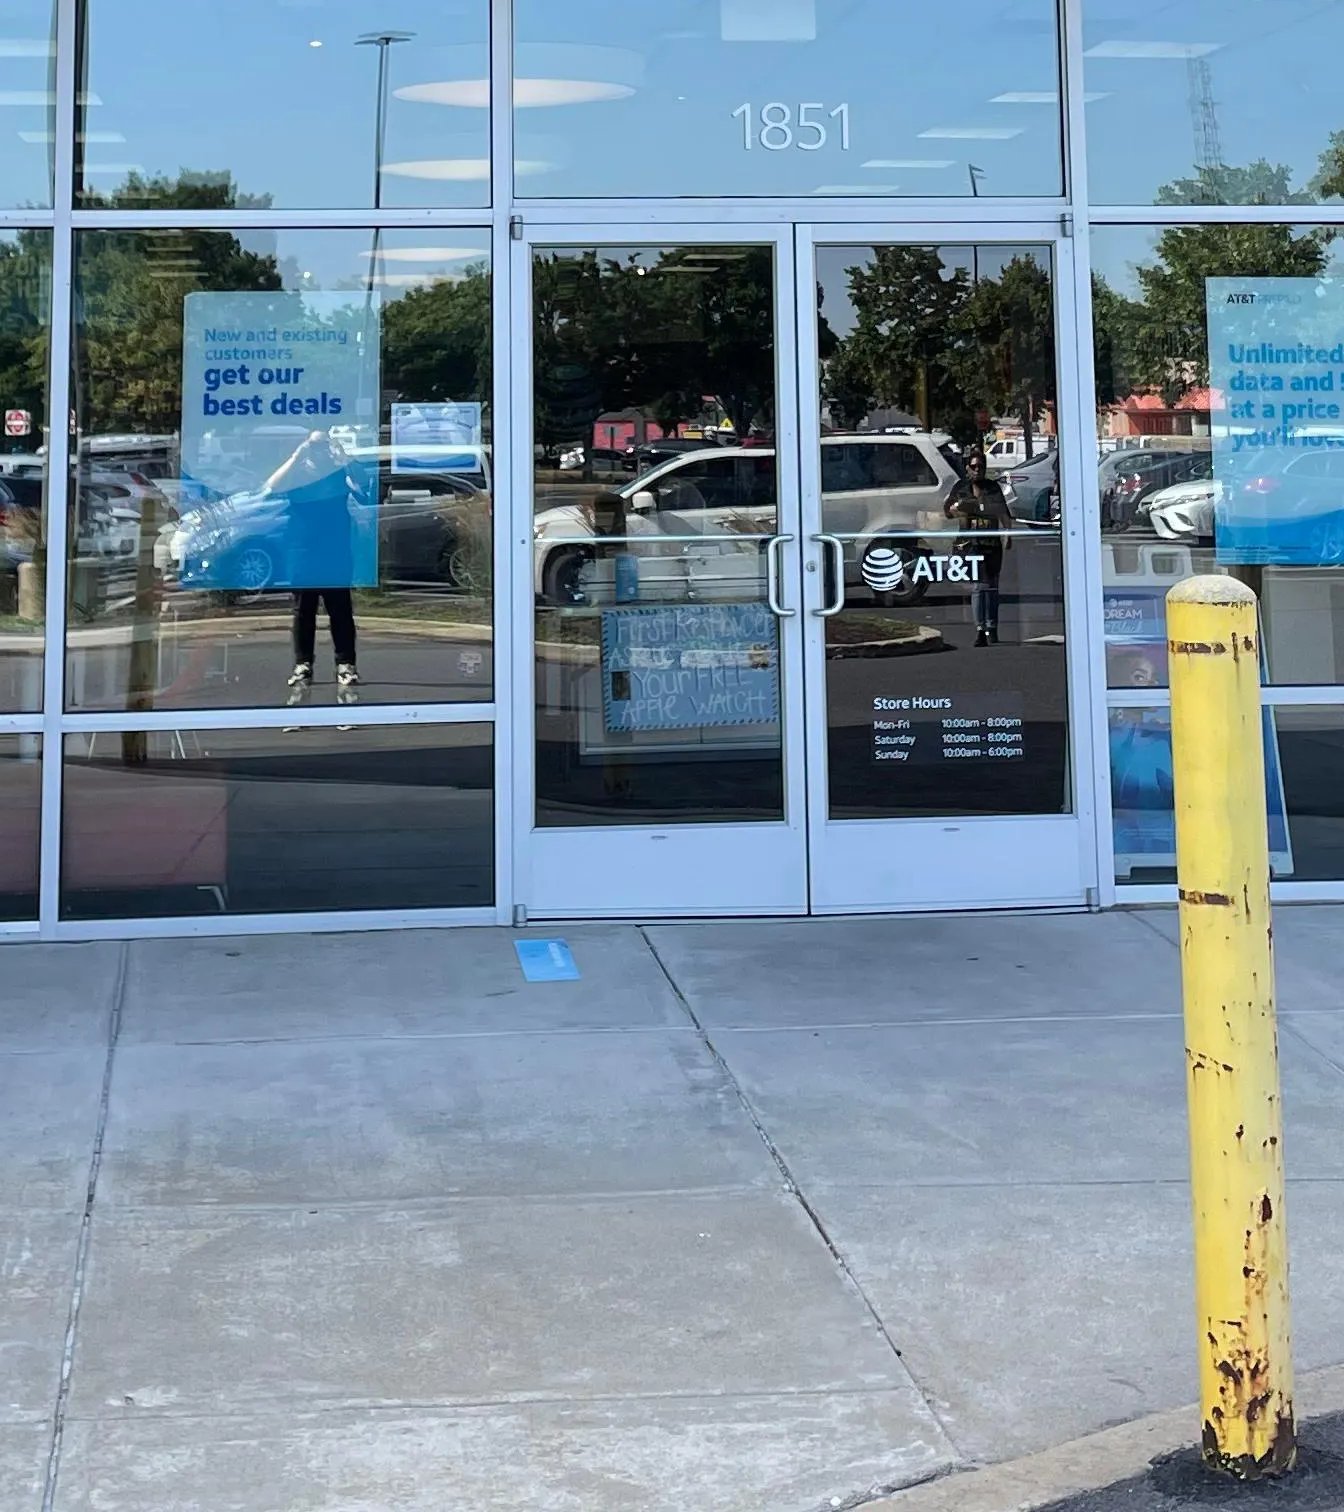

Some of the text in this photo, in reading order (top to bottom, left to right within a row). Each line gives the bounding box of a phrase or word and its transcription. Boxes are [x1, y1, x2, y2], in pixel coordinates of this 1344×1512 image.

[730, 101, 850, 151] 1851
[1226, 294, 1256, 304] AT&T
[204, 327, 349, 345] New and existing
[205, 346, 293, 360] customers
[1229, 343, 1344, 364] Unlimited
[204, 364, 304, 392] get our
[1230, 370, 1284, 392] data
[1290, 371, 1334, 392] and
[203, 392, 342, 416] best deals
[1231, 398, 1340, 424] at a price
[912, 555, 984, 583] AT&T
[1104, 608, 1143, 619] DREAM
[873, 696, 952, 711] Store Hours
[873, 719, 910, 730] Mon-Fri
[941, 718, 980, 729] 10:00am
[987, 717, 1022, 729] 8:00pm
[874, 735, 916, 746] Saturday
[942, 733, 980, 744] 10:00am
[987, 732, 1022, 744] 8:00pm
[875, 750, 909, 762] Sunday
[942, 748, 981, 759] 10:00am
[988, 747, 1023, 759] 6:00pm
